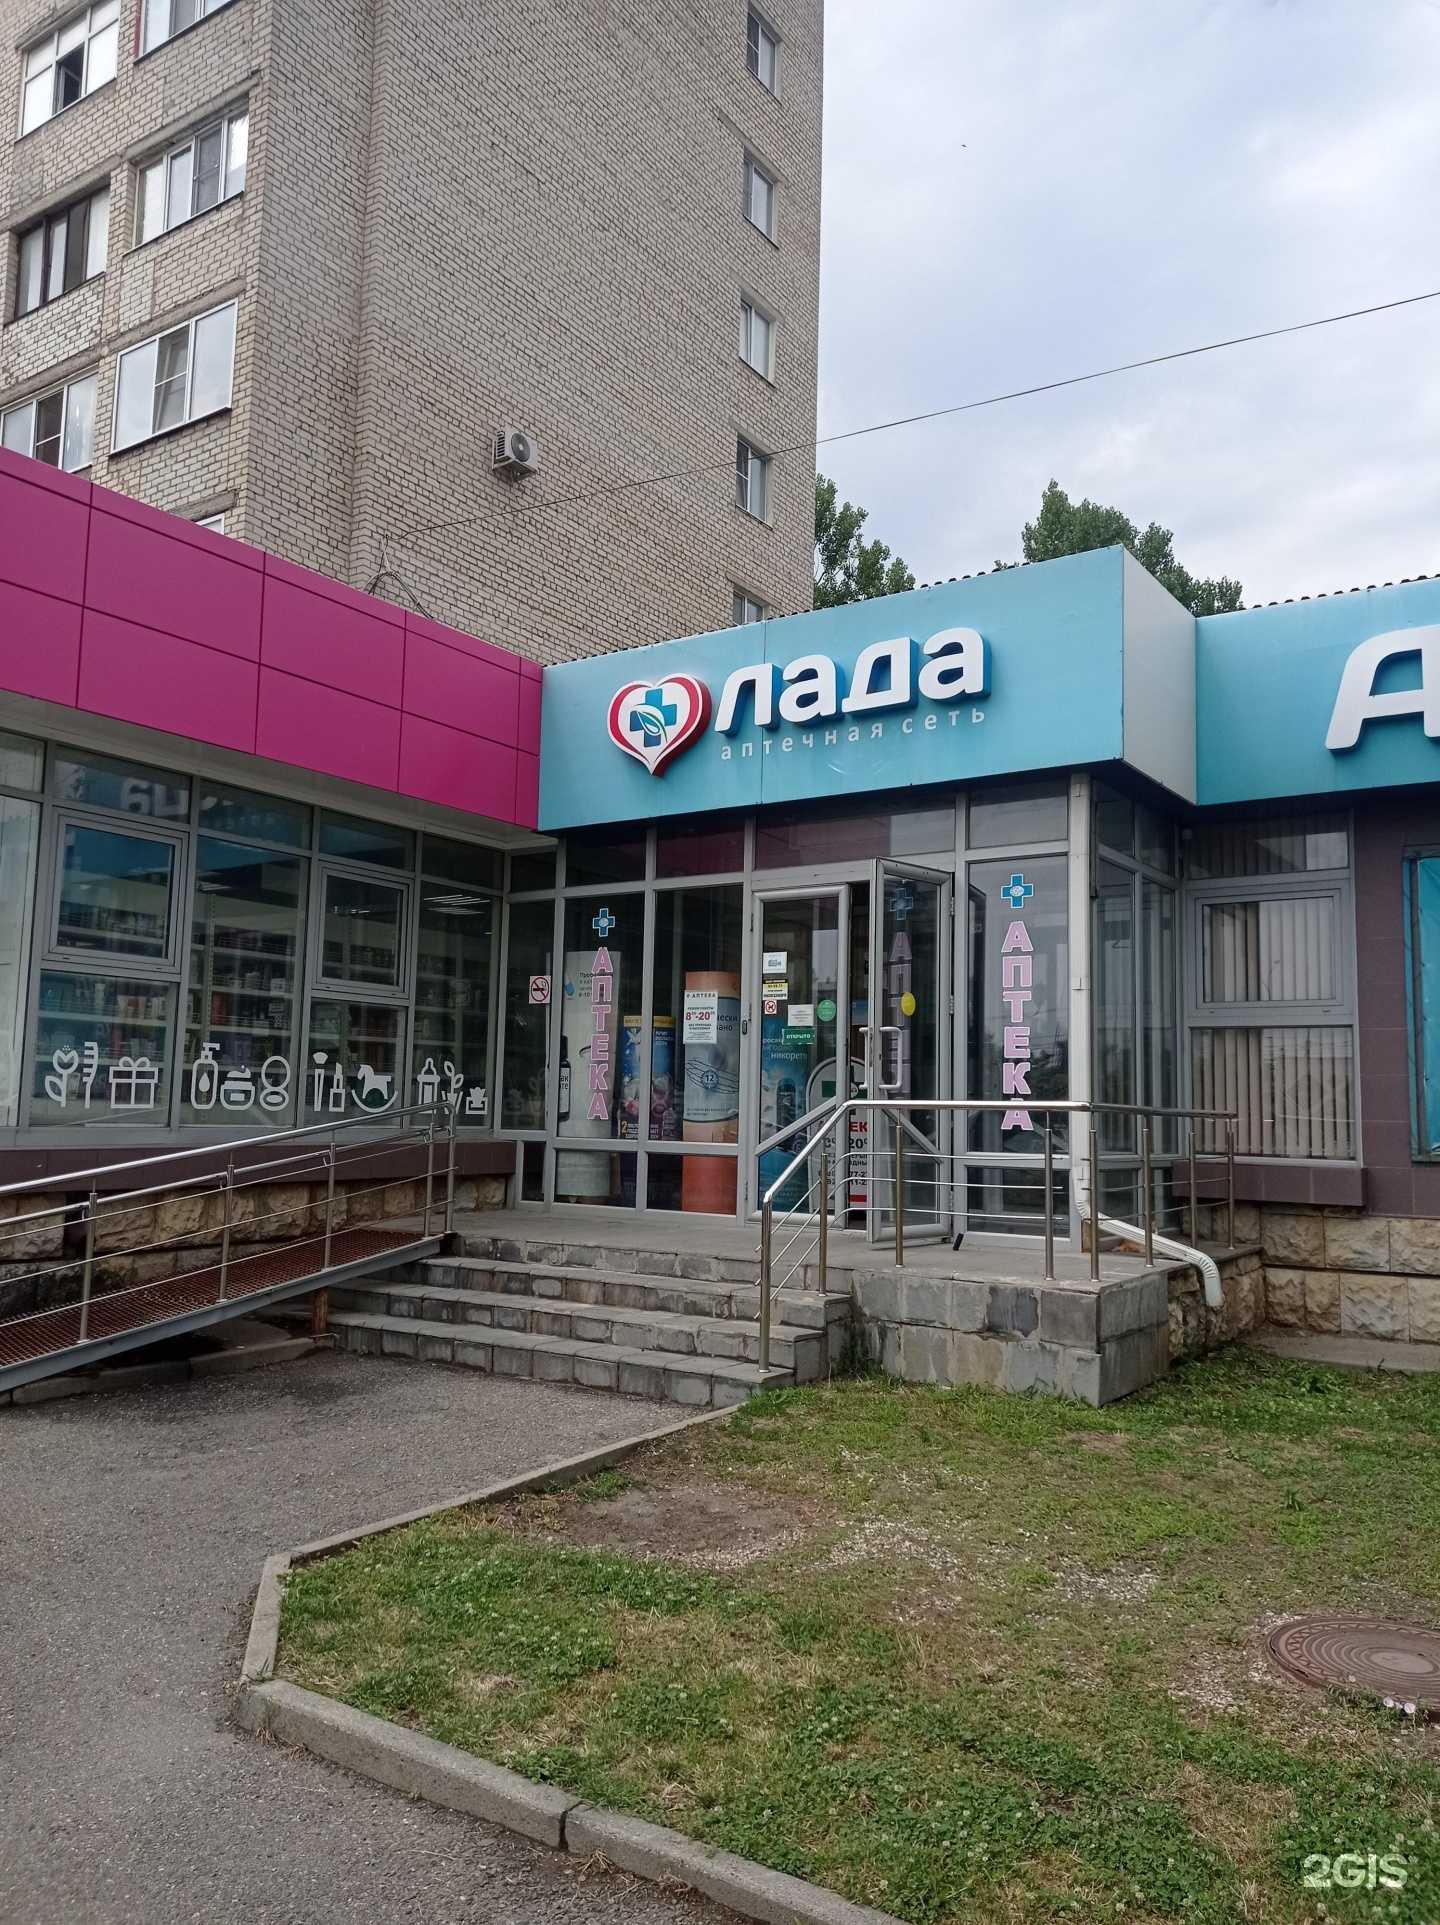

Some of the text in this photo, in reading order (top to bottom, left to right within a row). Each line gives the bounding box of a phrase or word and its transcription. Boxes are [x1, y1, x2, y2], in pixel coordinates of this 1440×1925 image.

[721, 705, 987, 762] аптечная сеть
[587, 946, 613, 1120] АПТЕКА
[1000, 920, 1034, 1130] АПТЕКА
